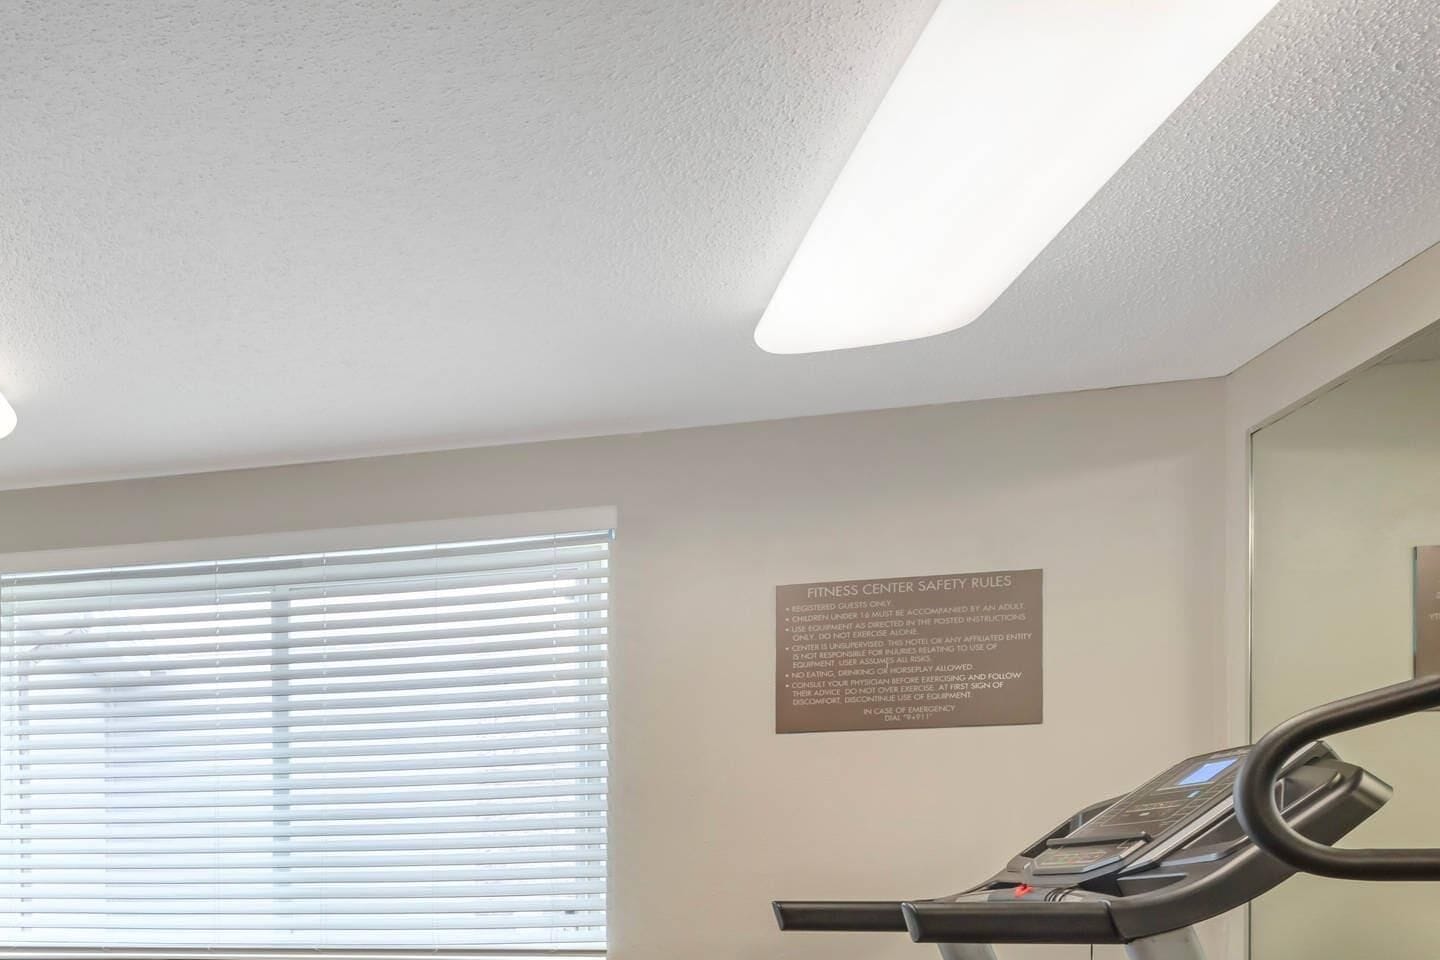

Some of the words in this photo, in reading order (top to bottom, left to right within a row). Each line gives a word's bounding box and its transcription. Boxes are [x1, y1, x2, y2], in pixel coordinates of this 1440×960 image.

[807, 585, 858, 598] FITNESS
[862, 581, 913, 595] CENTER
[918, 578, 967, 592] SAFETY
[971, 575, 1012, 588] RULES
[792, 602, 835, 612] REGISTERED
[838, 601, 867, 610] GUESTS
[792, 613, 830, 623] CHILDREN
[831, 612, 858, 621] UNDER
[871, 610, 893, 618] MUST
[907, 606, 968, 616] ACCOMPANIED
[982, 604, 996, 612] AN
[792, 624, 806, 633] USE
[808, 622, 853, 632] EQUIPMENT
[855, 622, 866, 630] AS
[868, 620, 904, 629] DIRECTED
[918, 618, 931, 626] THE
[934, 616, 964, 625] POSTED
[966, 614, 1026, 623] INSTRUCTIONS
[792, 643, 819, 652] CENTER
[906, 638, 928, 647] HOTEL
[944, 636, 962, 644] ANY
[963, 634, 1004, 644] AFFILIATED
[1006, 632, 1032, 641] ENTITY
[818, 632, 832, 641] DO
[833, 632, 851, 640] NOT
[852, 630, 888, 639] EXERCISE
[801, 652, 817, 660] NOT
[918, 645, 954, 654] RELATING
[958, 644, 968, 652] TO
[970, 644, 984, 652] USE
[986, 642, 998, 650] OF
[860, 657, 894, 666] ASSUMES
[792, 672, 805, 680] NO
[838, 668, 875, 677] DRINKING
[890, 666, 933, 675] HORSEPLAY
[827, 680, 848, 688] YOUR
[850, 678, 890, 687] PHYSICIAN
[892, 676, 919, 685] BEFORE
[922, 674, 966, 684] EXERCISING
[968, 673, 986, 681] AND
[988, 672, 1022, 680] FOLLOW
[792, 690, 812, 698] THEIR
[844, 688, 858, 696] DO
[860, 687, 876, 696] NOT
[878, 686, 900, 694] OVER
[938, 683, 949, 691] AT
[950, 682, 969, 690] FIRST
[970, 682, 991, 690] SIGN
[992, 681, 1004, 689] OF
[844, 694, 896, 704] DISCONTINUE
[897, 693, 912, 702] USE
[914, 692, 925, 700] OF
[864, 707, 872, 716] IN
[873, 706, 894, 715] CASE
[896, 706, 906, 714] OF
[908, 704, 956, 714] EMERGENCY
[884, 714, 900, 722] DIAL
